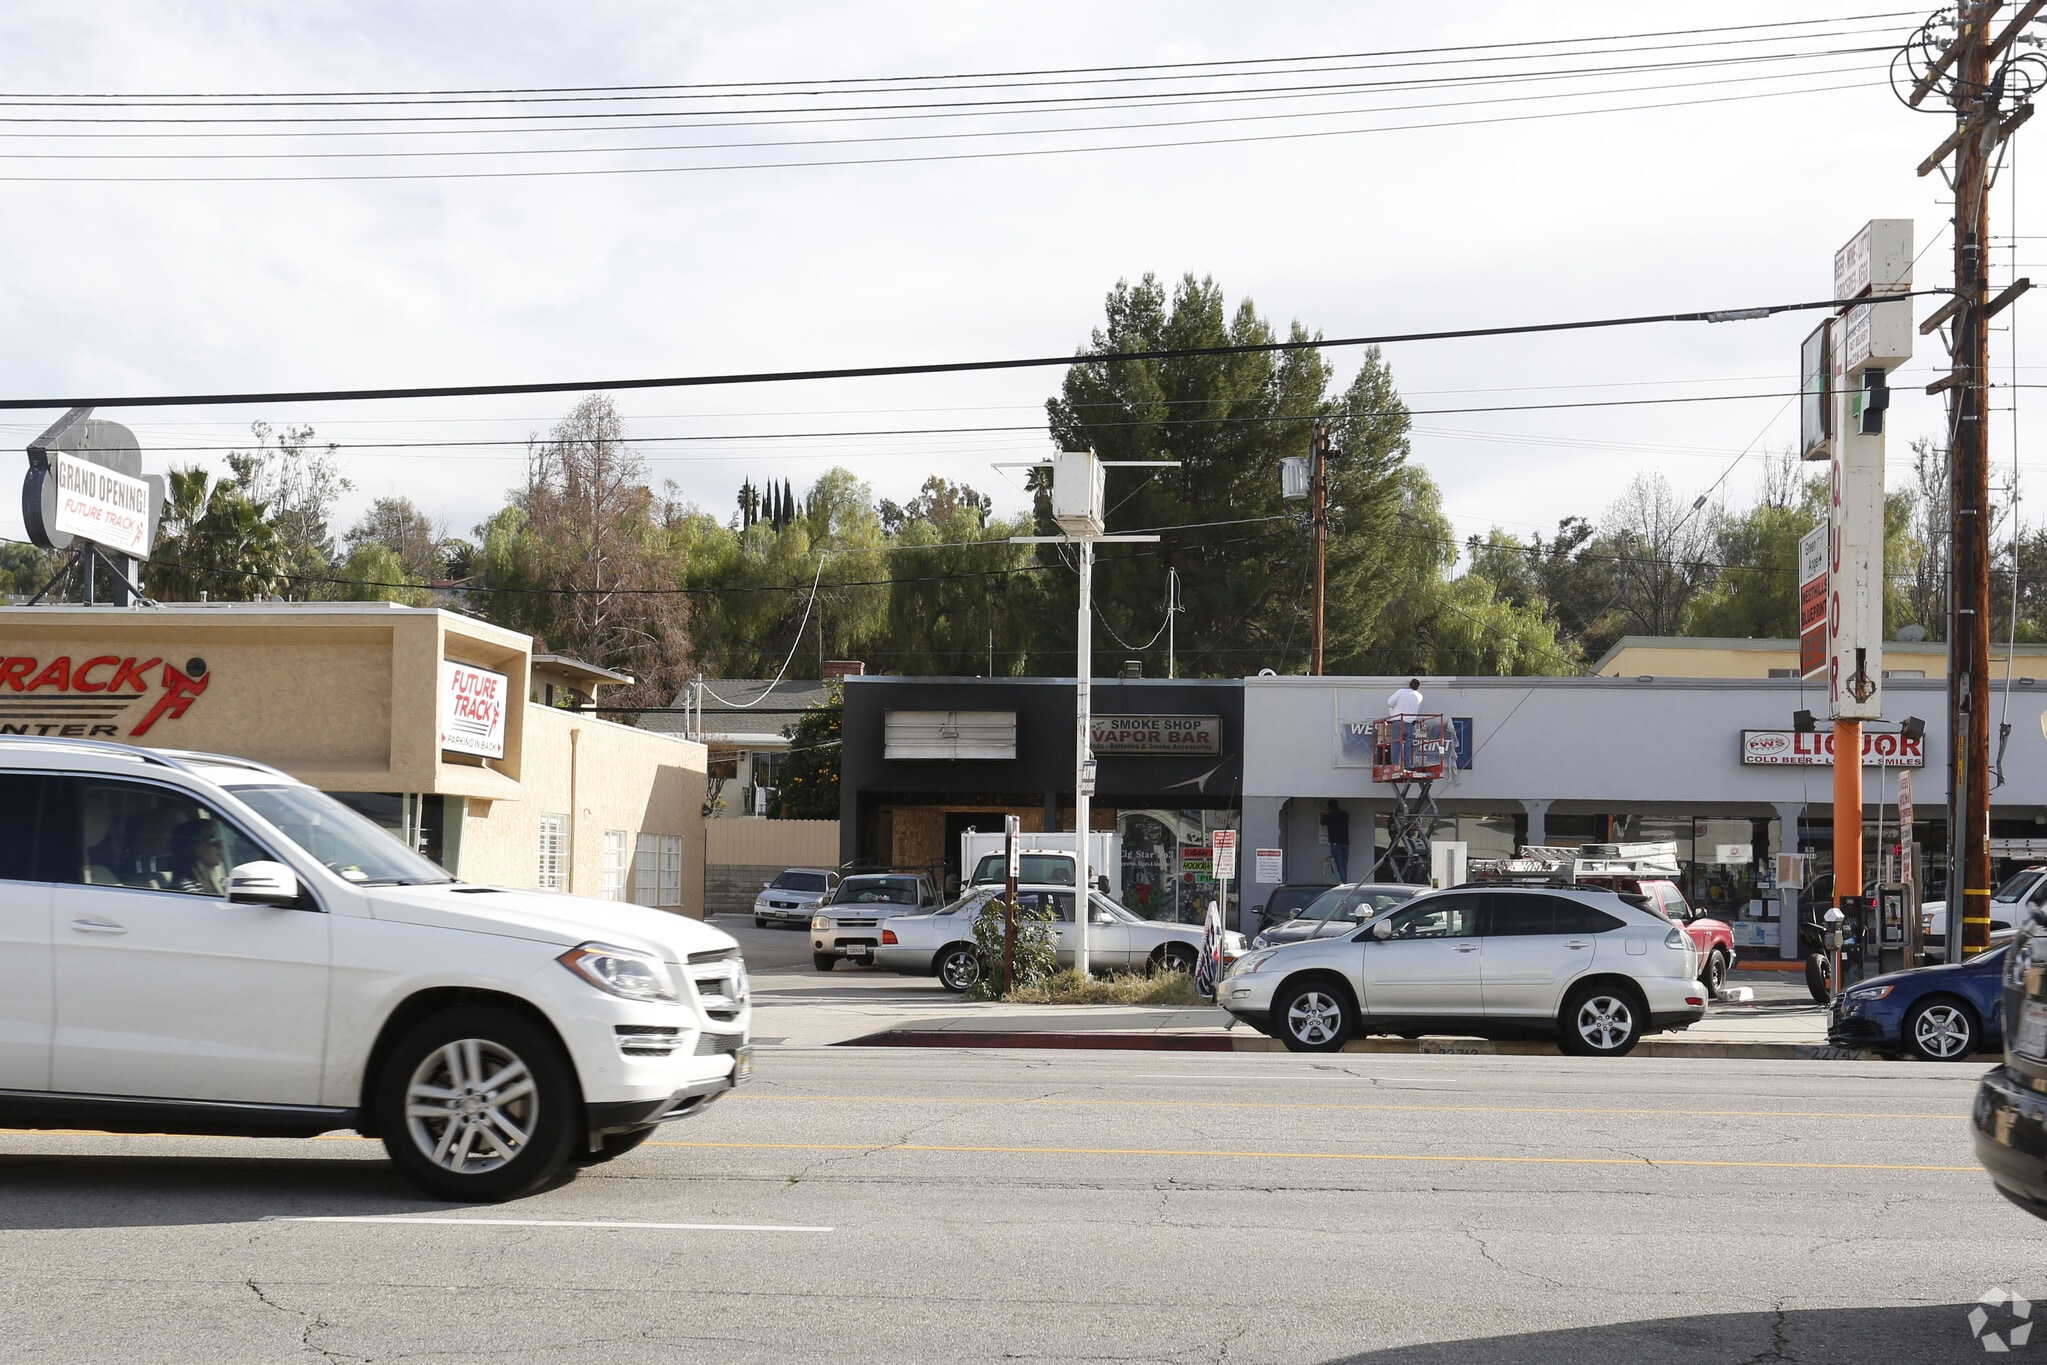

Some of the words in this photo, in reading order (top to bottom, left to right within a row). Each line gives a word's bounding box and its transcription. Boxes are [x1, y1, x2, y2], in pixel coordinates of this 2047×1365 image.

[58, 461, 96, 498] GRAND
[99, 475, 147, 515] OPENING!
[64, 498, 102, 521] FUTURE
[104, 511, 136, 532] TRACK
[0, 655, 163, 693] RACK
[452, 669, 498, 700] FUTURE
[454, 694, 493, 722] TRACK
[1111, 719, 1160, 730] SMOKE
[1164, 720, 1201, 730] SHOP
[447, 734, 474, 748] PARKING
[481, 741, 497, 751] BACK
[1091, 730, 1161, 743] VAPOR
[1168, 731, 1210, 743] BAR
[1749, 738, 1786, 749] PWS
[1109, 742, 1139, 750] Batteries
[1172, 743, 1213, 751] Accessories
[1746, 755, 1779, 763] COLD
[1781, 756, 1813, 764] BEER
[1135, 850, 1154, 859] Star
